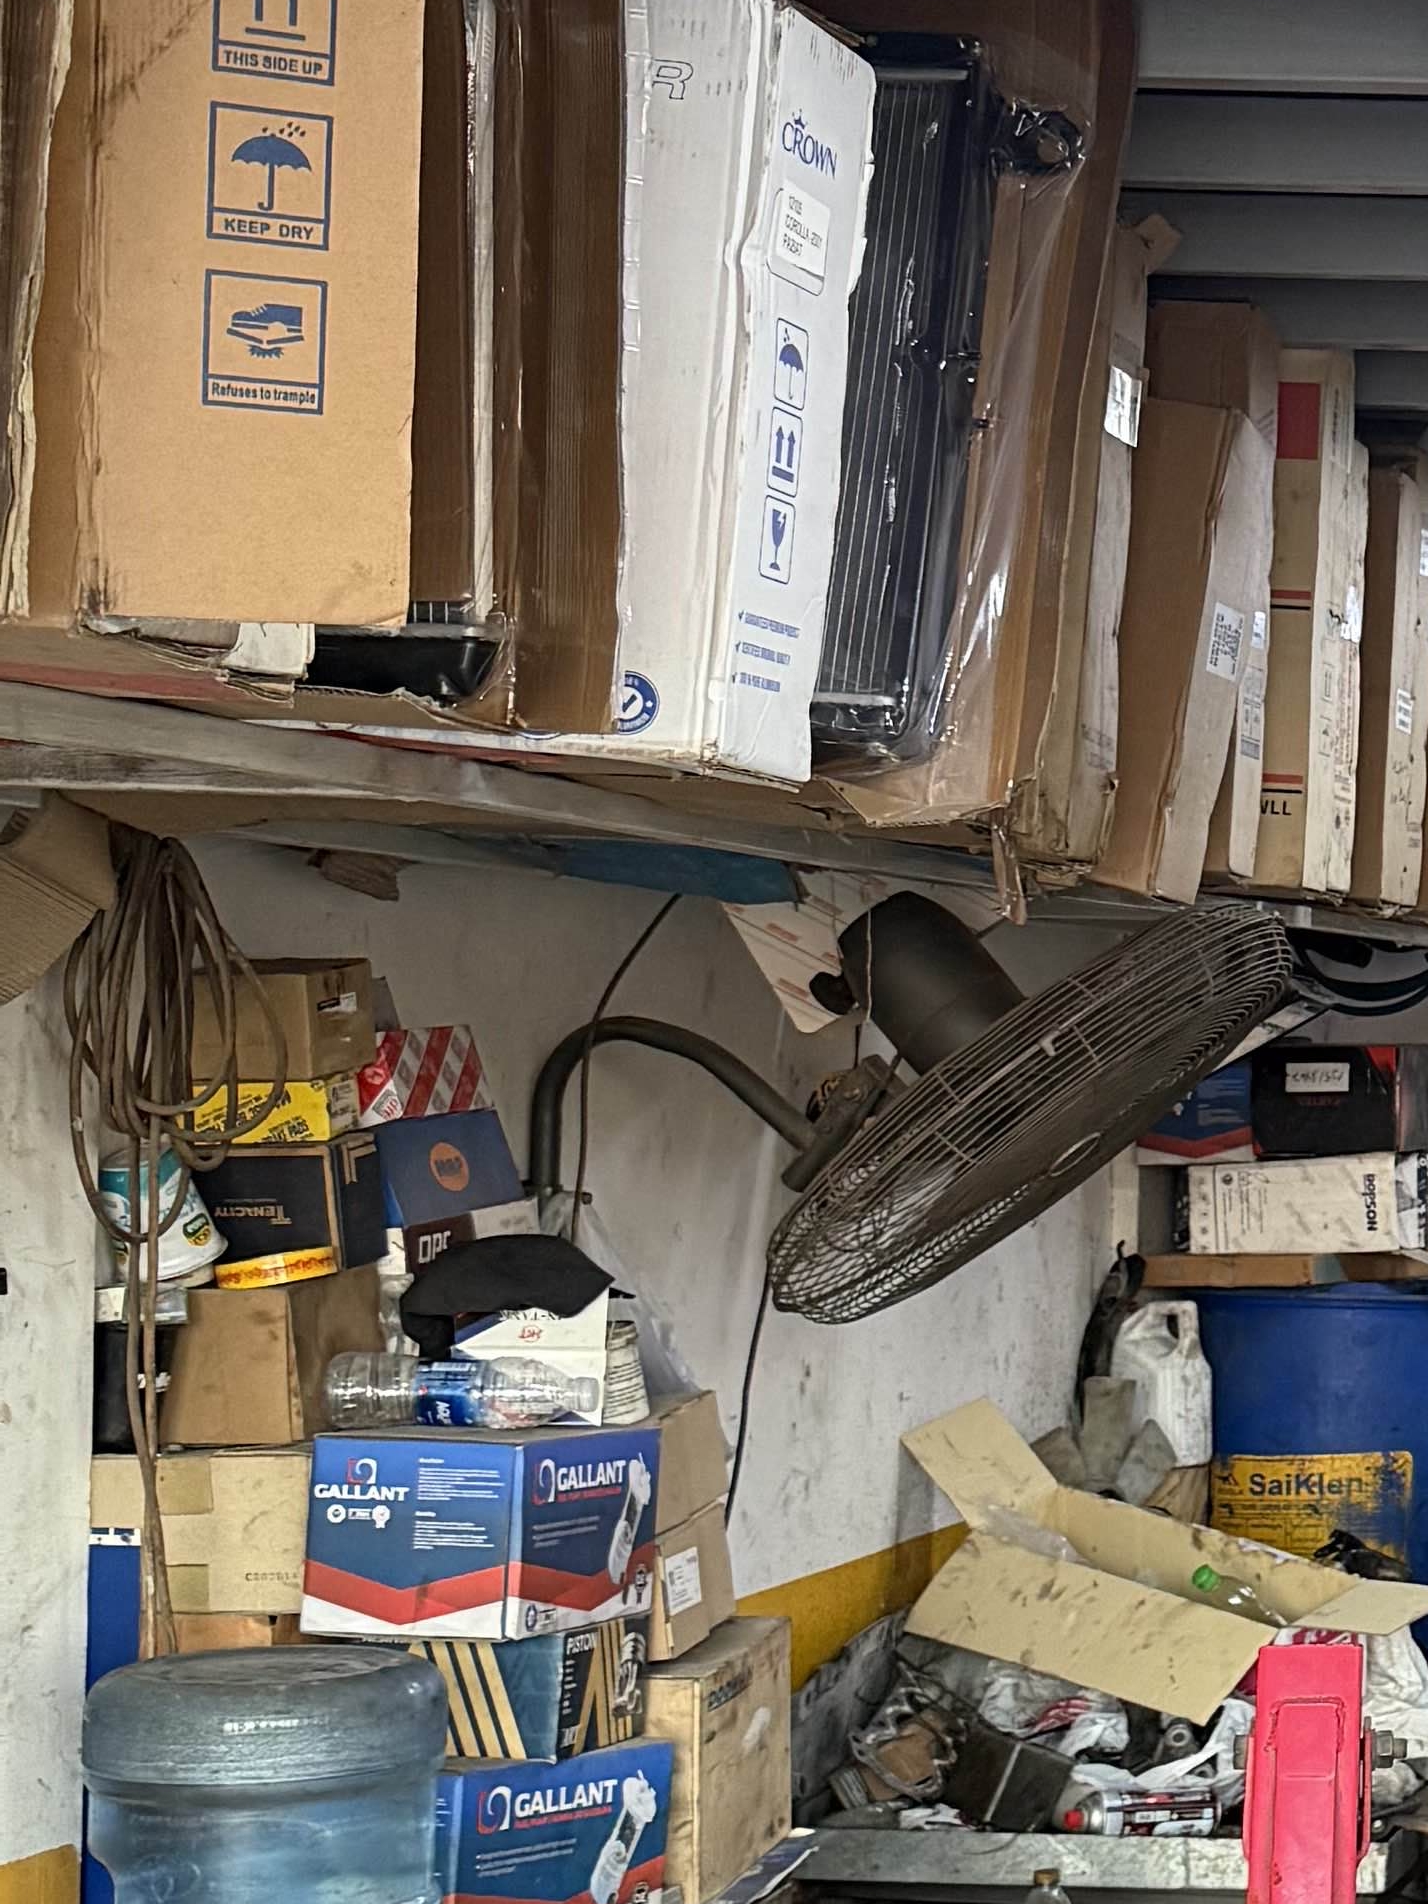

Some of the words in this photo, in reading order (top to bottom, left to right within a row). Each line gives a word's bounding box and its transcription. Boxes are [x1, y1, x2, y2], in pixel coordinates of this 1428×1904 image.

[224, 49, 259, 68] THIS
[262, 53, 298, 73] SIDE
[301, 58, 323, 76] UP
[782, 121, 838, 180] CROWN
[223, 216, 271, 235] KEEP
[278, 222, 314, 241] DRY
[211, 382, 255, 400] Refuses
[257, 386, 272, 400] to
[271, 386, 316, 405] trample
[215, 1203, 292, 1226] TENACITY
[557, 1459, 627, 1492] GALLANT
[1249, 1472, 1364, 1497] SaiKlen
[314, 1483, 410, 1502] GALLANT
[514, 1778, 619, 1819] GALLANT
